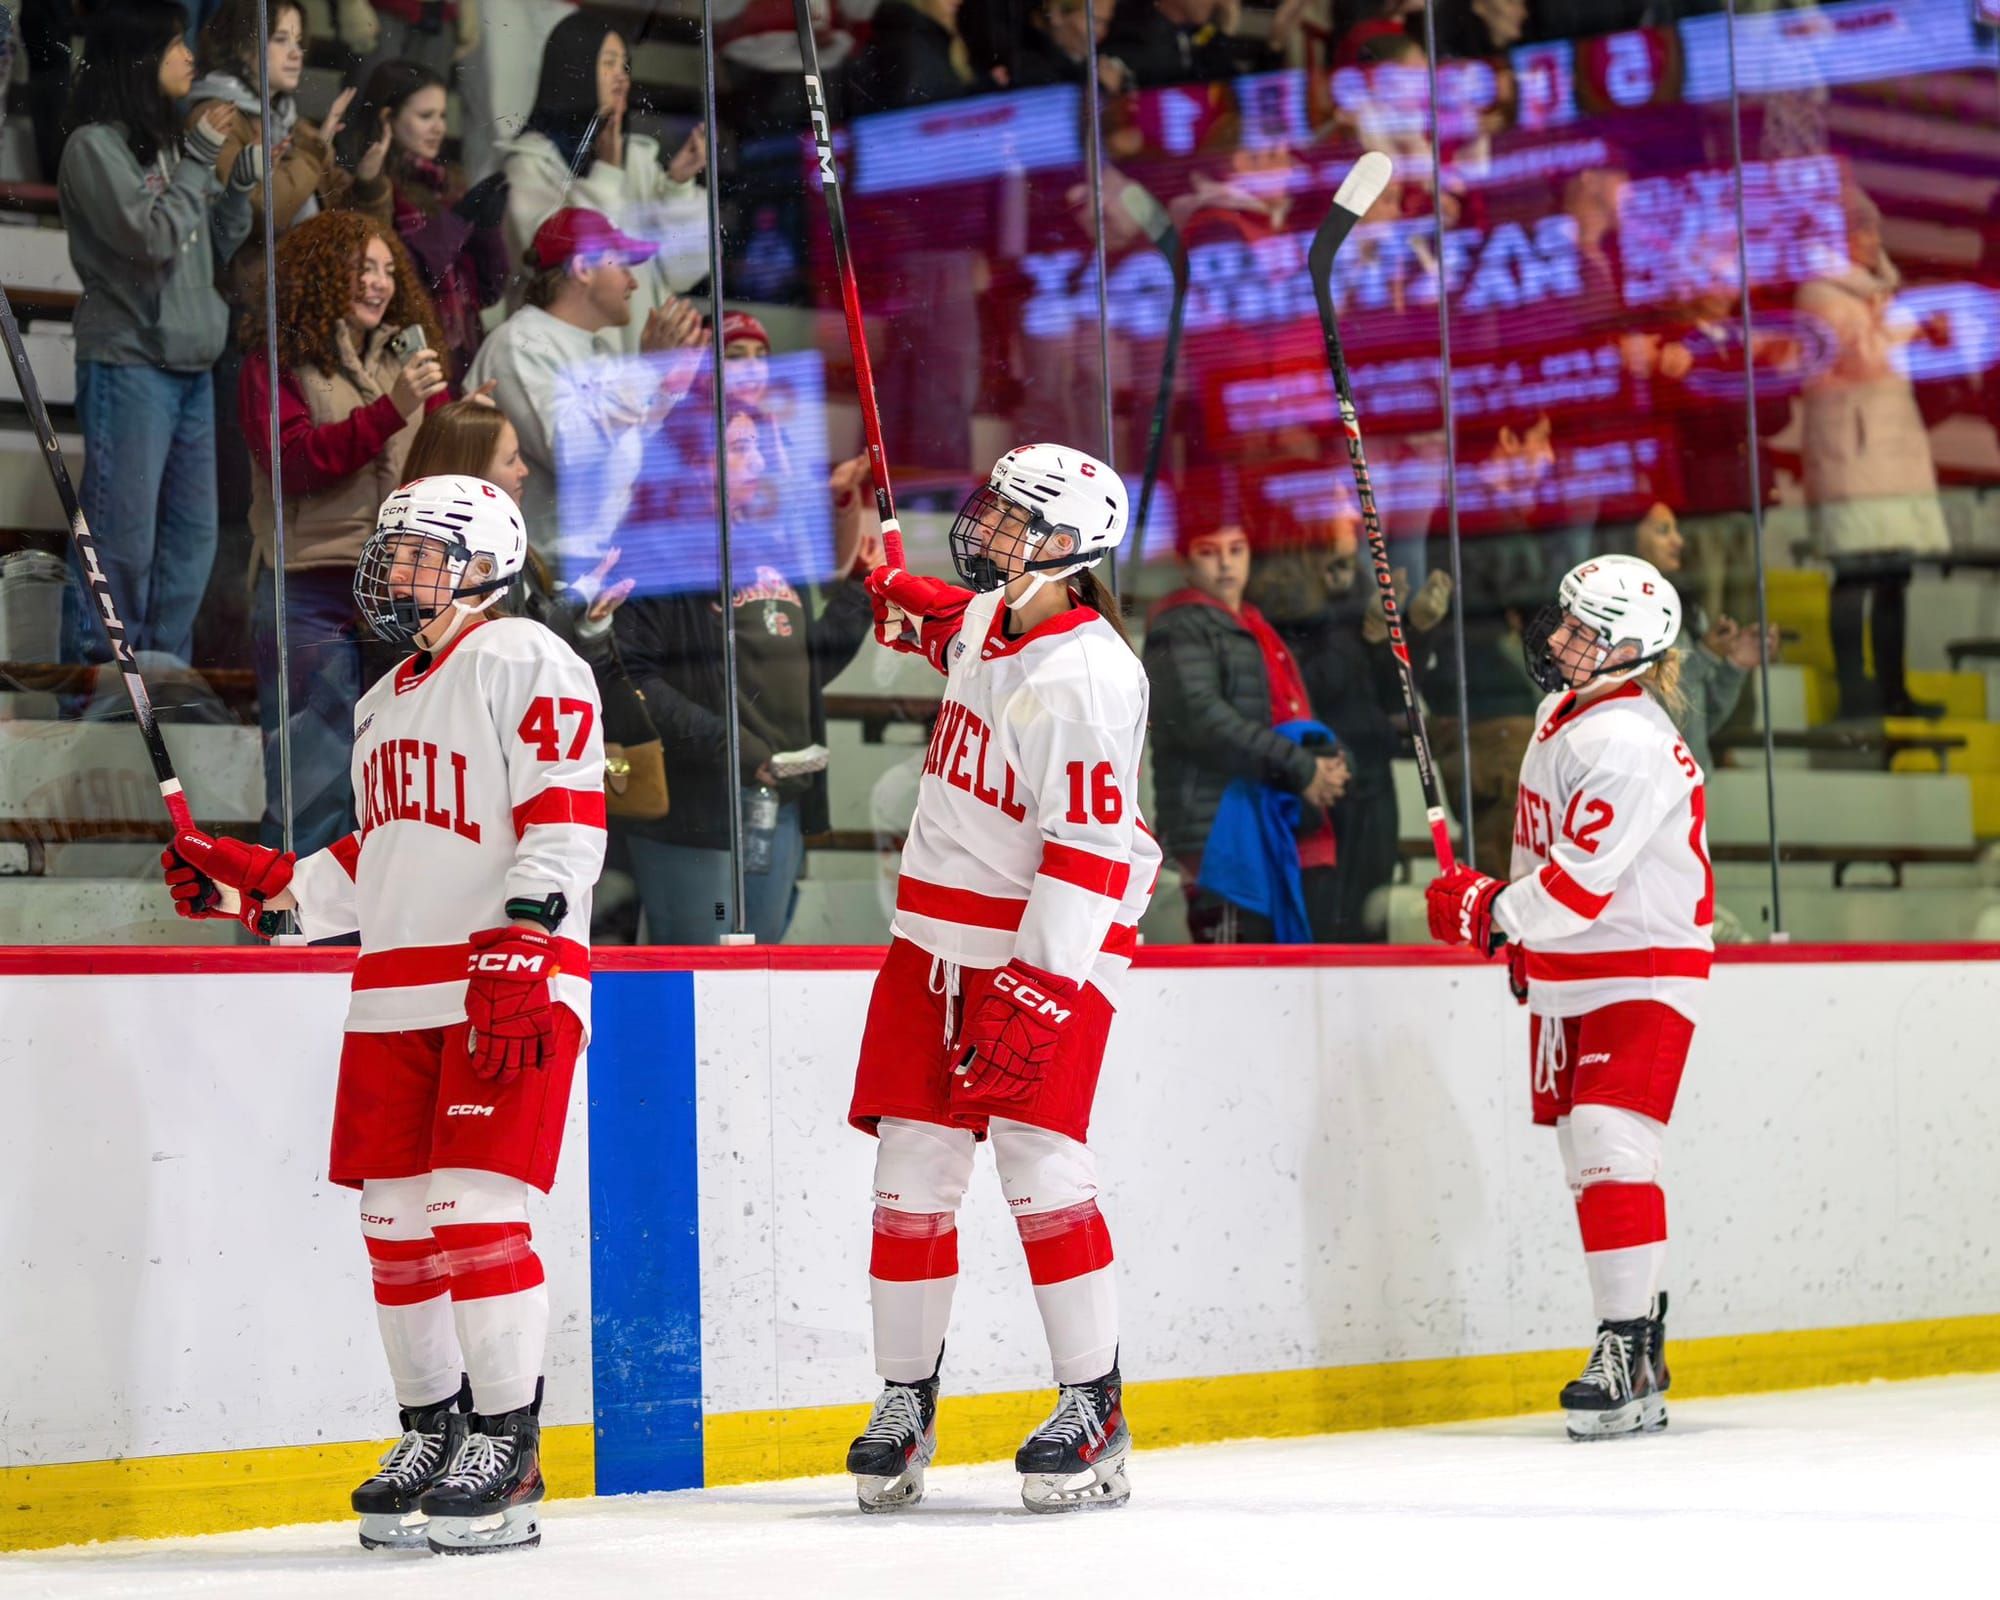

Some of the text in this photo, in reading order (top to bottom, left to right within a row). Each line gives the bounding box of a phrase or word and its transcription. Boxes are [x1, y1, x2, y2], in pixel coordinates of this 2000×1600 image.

[804, 74, 837, 184] CCM
[382, 506, 408, 516] CCM
[1347, 438, 1406, 645] SHERWOOD
[517, 696, 594, 763] 47
[360, 738, 482, 847] ORNELL
[1065, 760, 1123, 825] 16
[184, 835, 213, 850] CCM
[1561, 788, 1615, 855] 12
[992, 971, 1071, 1024] CCM
[1578, 1052, 1612, 1066] CCM
[447, 1104, 495, 1117] CCM
[360, 1212, 395, 1225] CCM
[425, 1200, 456, 1213] CCM
